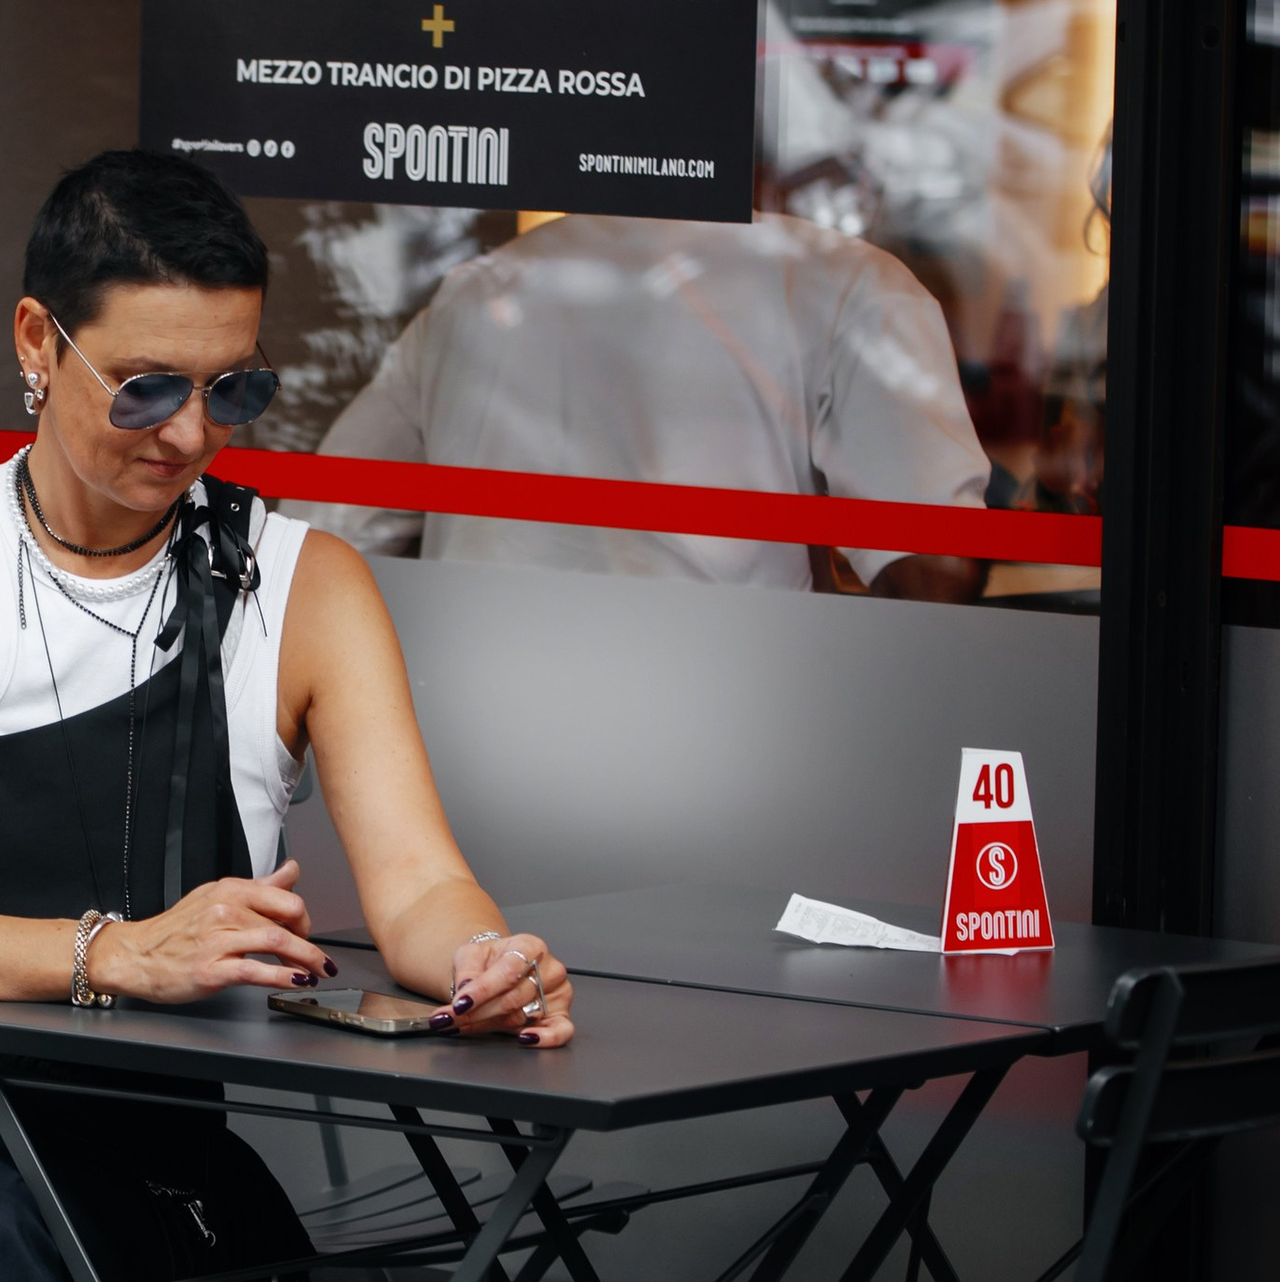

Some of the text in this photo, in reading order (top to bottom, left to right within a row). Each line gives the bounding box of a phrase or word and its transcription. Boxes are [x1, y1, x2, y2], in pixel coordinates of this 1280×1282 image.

[236, 58, 646, 98] MEZZO TRANCIO DI PIZZA ROSSA
[362, 122, 510, 186] SPONTINI
[578, 153, 715, 179] SPONTINIMILANO.COM
[971, 762, 1015, 810] 40
[956, 909, 1040, 941] SPONTINI
